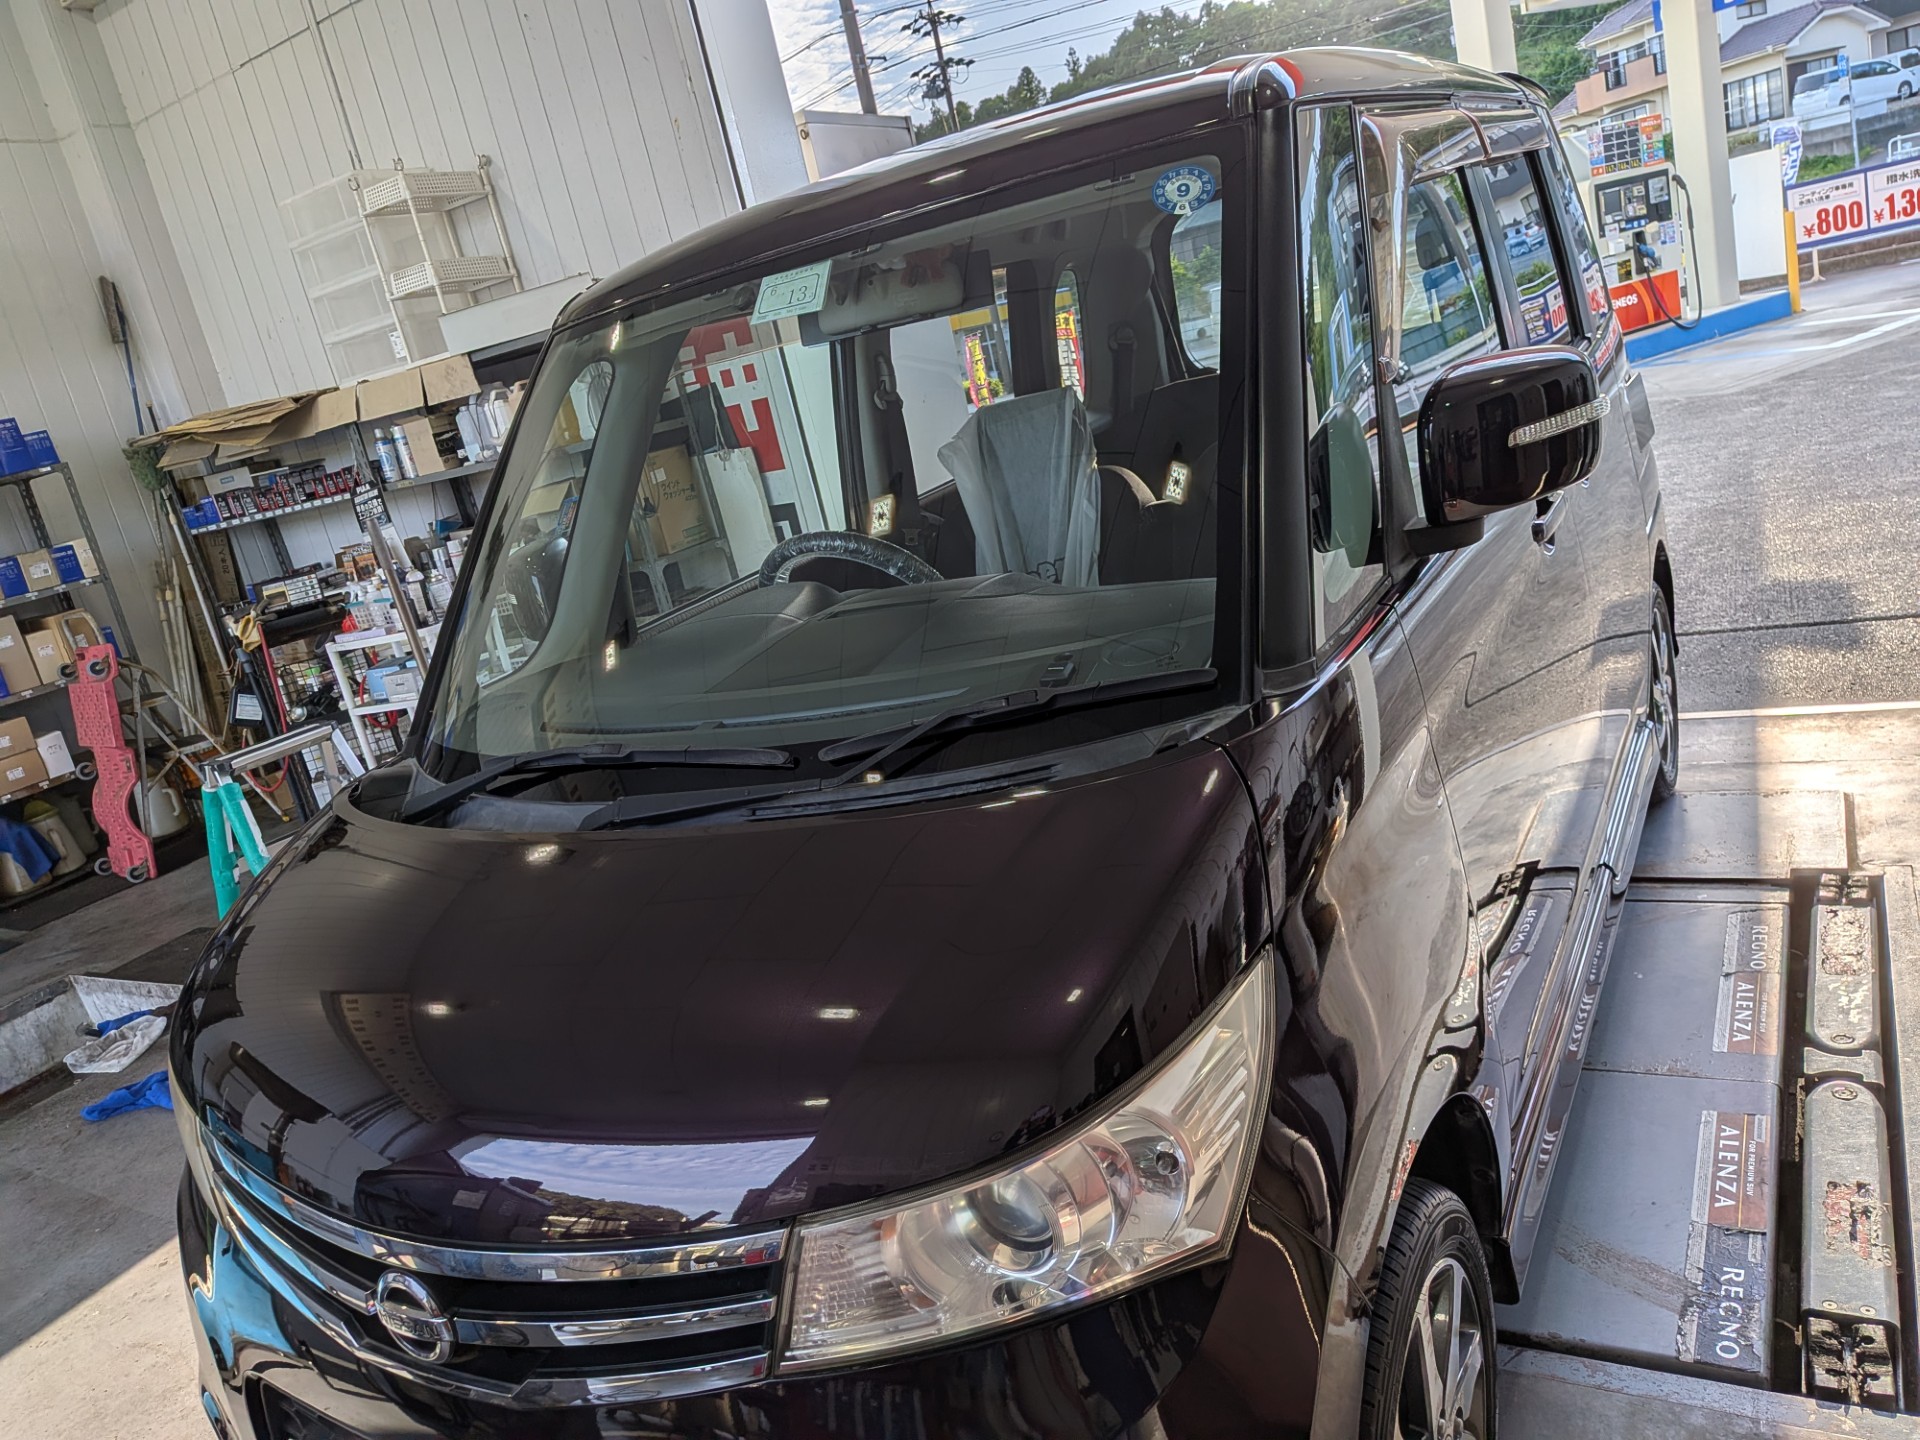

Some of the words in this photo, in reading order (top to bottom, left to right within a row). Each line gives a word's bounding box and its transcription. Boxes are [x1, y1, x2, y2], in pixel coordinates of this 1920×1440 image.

[1158, 196, 1166, 204] 8
[1176, 183, 1191, 198] 9
[1179, 203, 1186, 211] 6
[1874, 188, 1920, 223] ¥1,3
[786, 285, 808, 305] 13
[1750, 925, 1769, 971] REGNO
[1732, 981, 1755, 1042] ALENZA
[1748, 1140, 1757, 1153] FOR
[1714, 1124, 1740, 1208] ALENZA
[1746, 1154, 1756, 1182] PREMIUM
[1746, 1183, 1754, 1197] SUV
